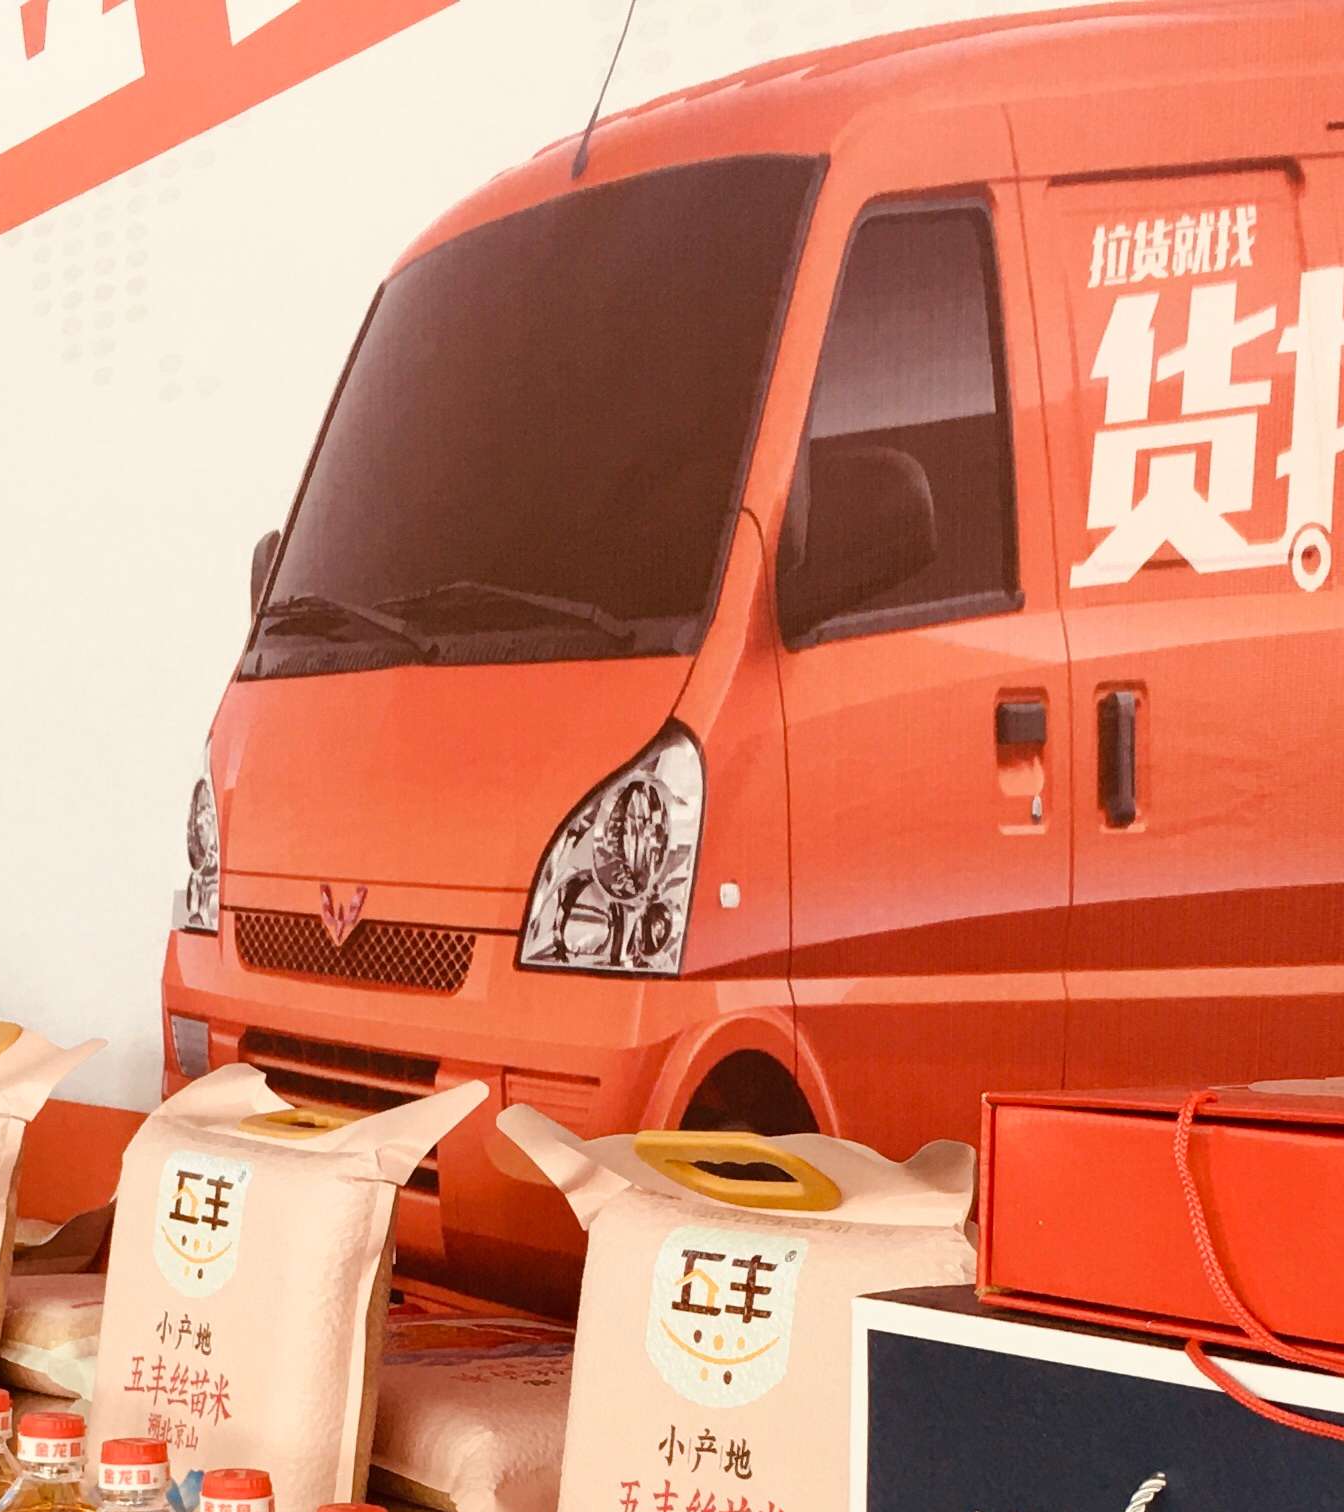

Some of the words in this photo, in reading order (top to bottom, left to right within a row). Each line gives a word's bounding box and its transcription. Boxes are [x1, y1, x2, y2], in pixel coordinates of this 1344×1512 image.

[1087, 206, 1257, 289] 拉货就找
[156, 1311, 212, 1356] 小产地
[123, 1355, 232, 1426] 五丰丝苗米
[658, 1424, 753, 1480] 小产地
